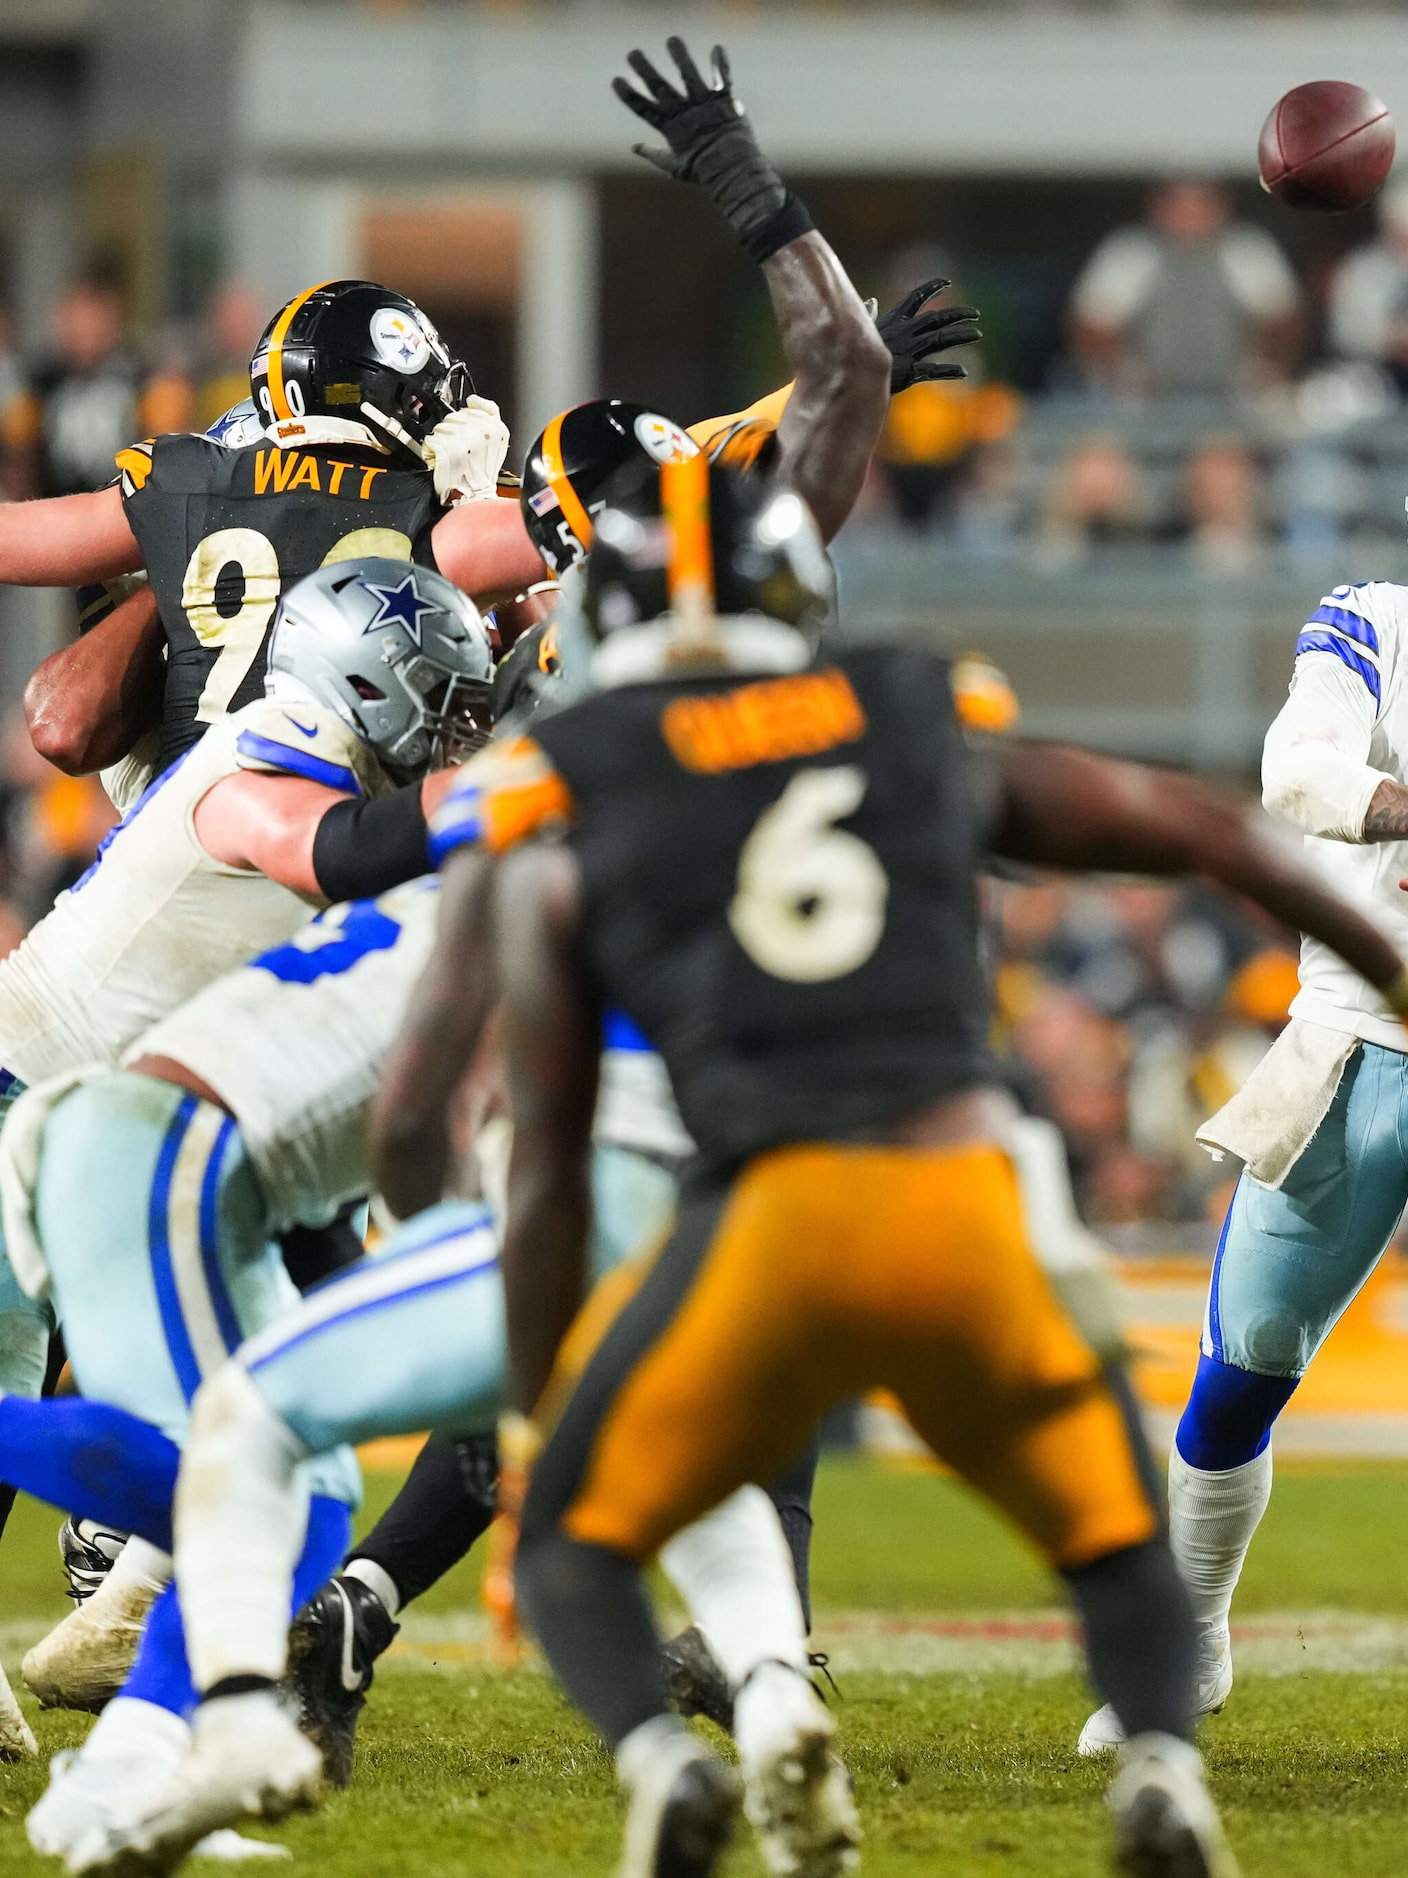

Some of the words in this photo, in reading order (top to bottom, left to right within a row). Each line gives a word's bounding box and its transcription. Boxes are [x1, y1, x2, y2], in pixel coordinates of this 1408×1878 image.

[254, 447, 388, 500] WATT
[277, 423, 306, 439] Steelers
[181, 527, 415, 724] 9
[728, 762, 890, 984] 6
